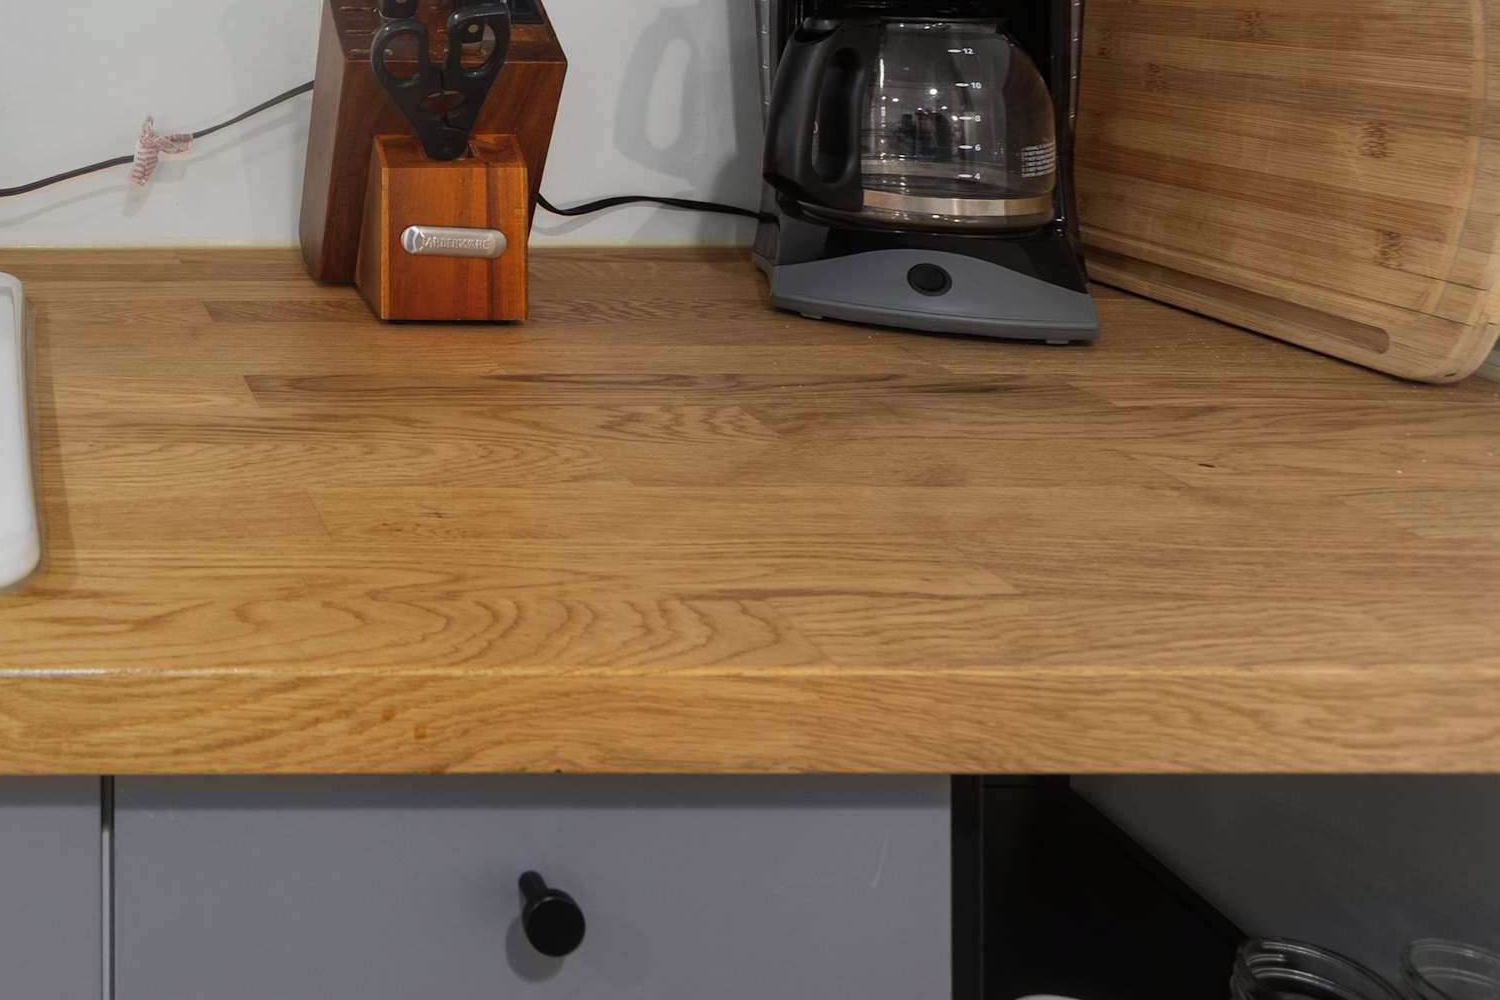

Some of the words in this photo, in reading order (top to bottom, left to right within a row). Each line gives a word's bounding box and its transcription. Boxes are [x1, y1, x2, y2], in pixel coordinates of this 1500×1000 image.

[974, 114, 981, 122] 8
[974, 144, 981, 152] 6
[974, 172, 981, 180] 4
